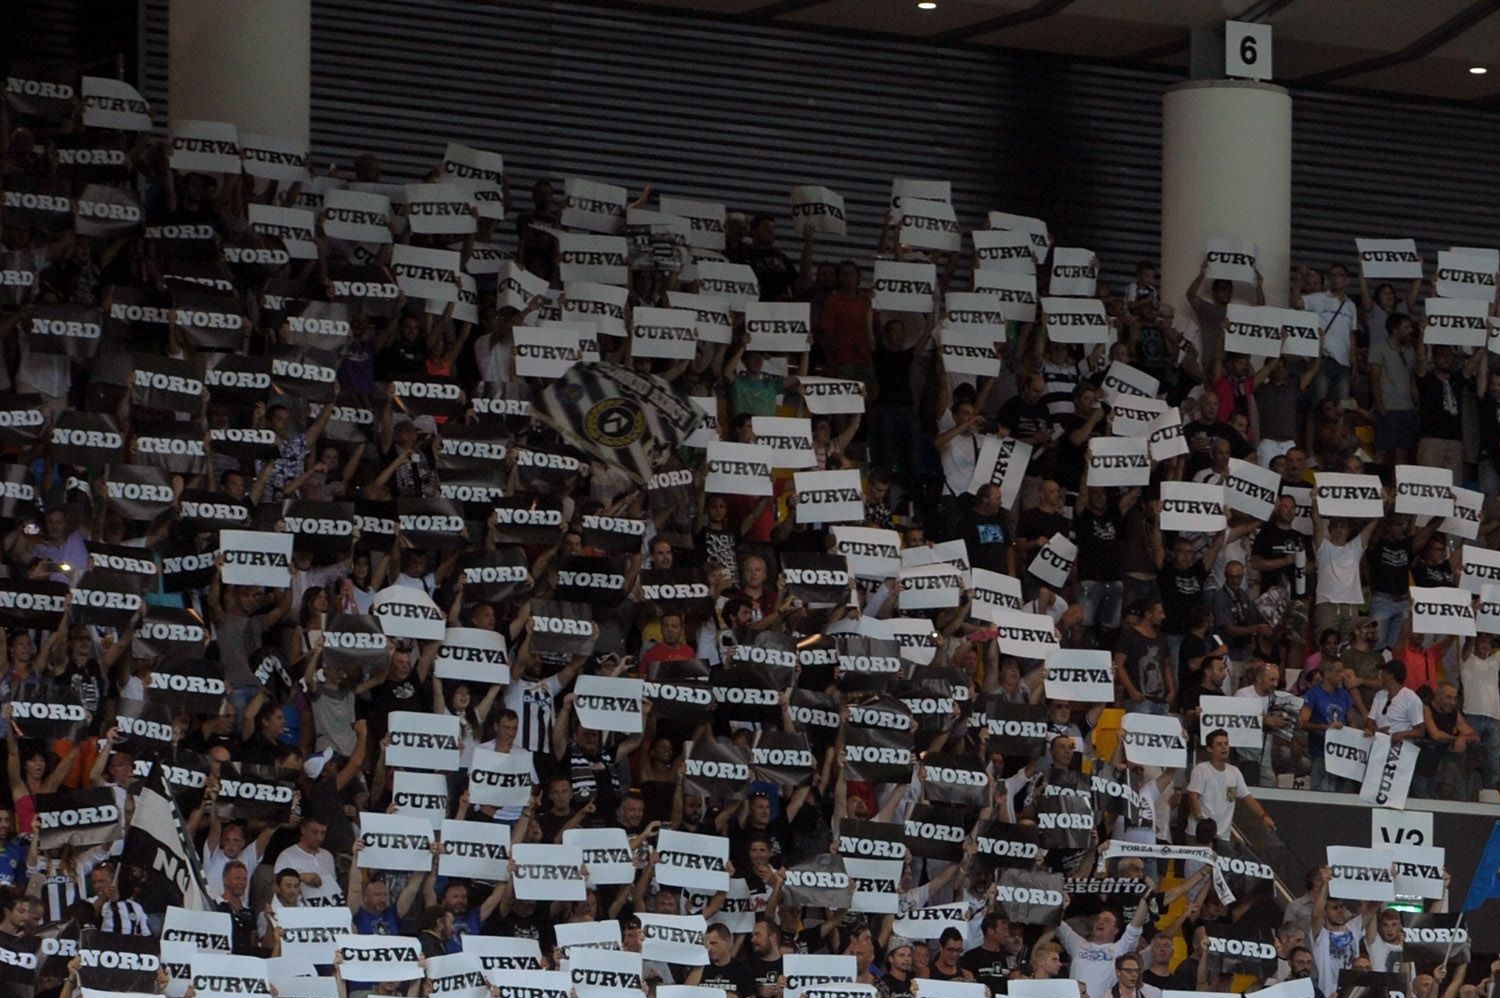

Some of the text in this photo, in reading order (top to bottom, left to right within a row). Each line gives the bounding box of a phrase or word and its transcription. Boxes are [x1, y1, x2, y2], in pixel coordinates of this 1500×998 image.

[1241, 35, 1257, 65] 6
[395, 263, 456, 282] CURVA
[1439, 269, 1494, 285] CURVA
[747, 320, 809, 334] CURVA
[1049, 313, 1106, 326] CURVA
[1429, 315, 1487, 329] CURVA
[517, 344, 577, 360] CURVA
[393, 381, 460, 399] NORD
[804, 382, 861, 395] CURVA
[211, 429, 275, 443] NORD
[514, 450, 580, 470] NORD
[1163, 500, 1223, 517] CURVA
[1414, 602, 1473, 618] CURVA
[439, 646, 507, 664] CURVA
[148, 672, 225, 694] NORD
[1046, 668, 1111, 684] CURVA
[576, 695, 640, 713] CURVA
[685, 761, 749, 779] NORD
[219, 780, 293, 802] NORD
[444, 840, 508, 859] CURVA
[839, 836, 907, 858] NORD
[1063, 882, 1148, 894] SEGUITO
[339, 947, 420, 962] CURVA
[1208, 936, 1276, 959] NORD
[79, 950, 159, 971] NORD
